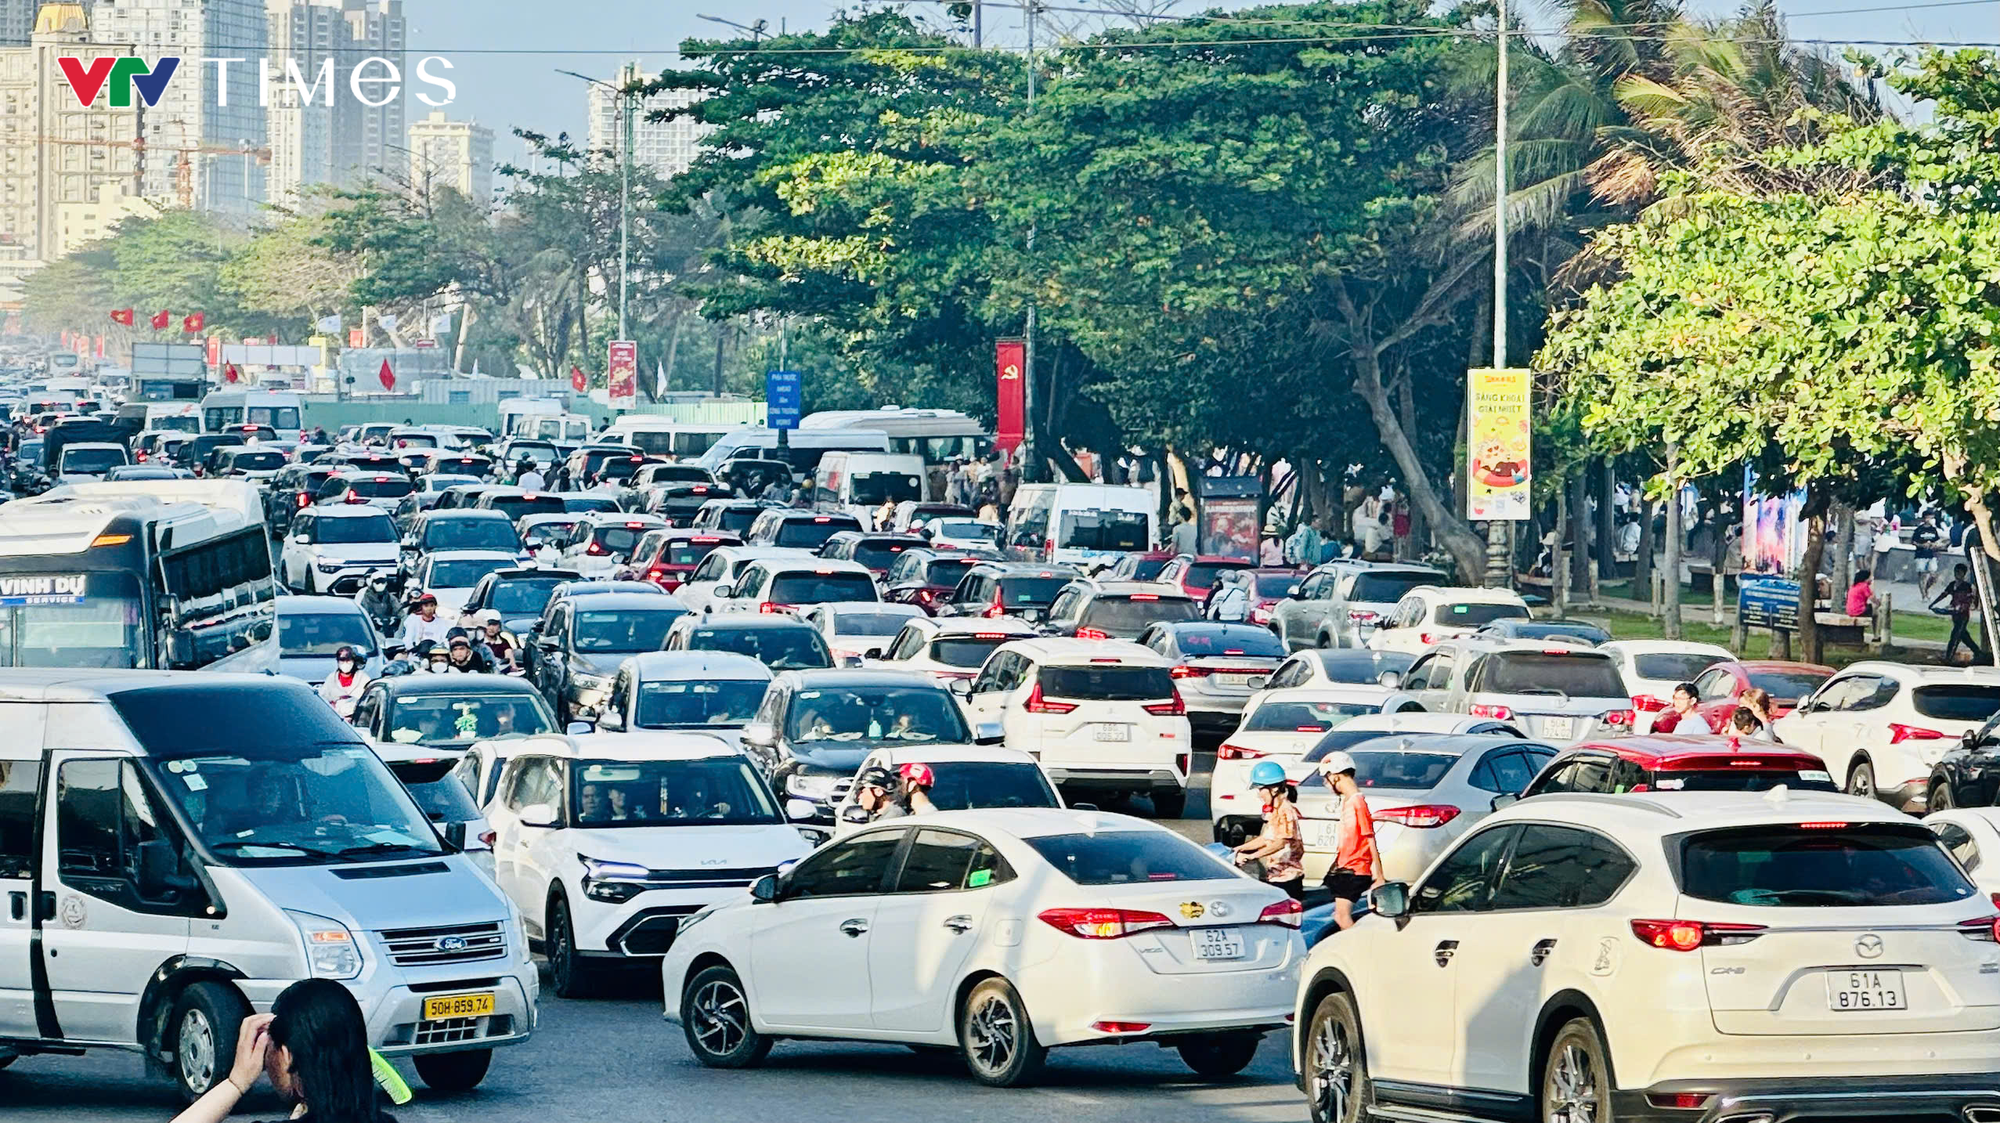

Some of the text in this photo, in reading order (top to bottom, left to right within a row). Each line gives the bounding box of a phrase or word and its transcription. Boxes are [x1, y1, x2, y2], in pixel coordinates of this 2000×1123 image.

[1206, 930, 1228, 943] 62A
[444, 938, 463, 950] Ford
[1201, 943, 1239, 957] 309.57
[1850, 972, 1882, 989] 61A
[1839, 991, 1897, 1007] 876.13
